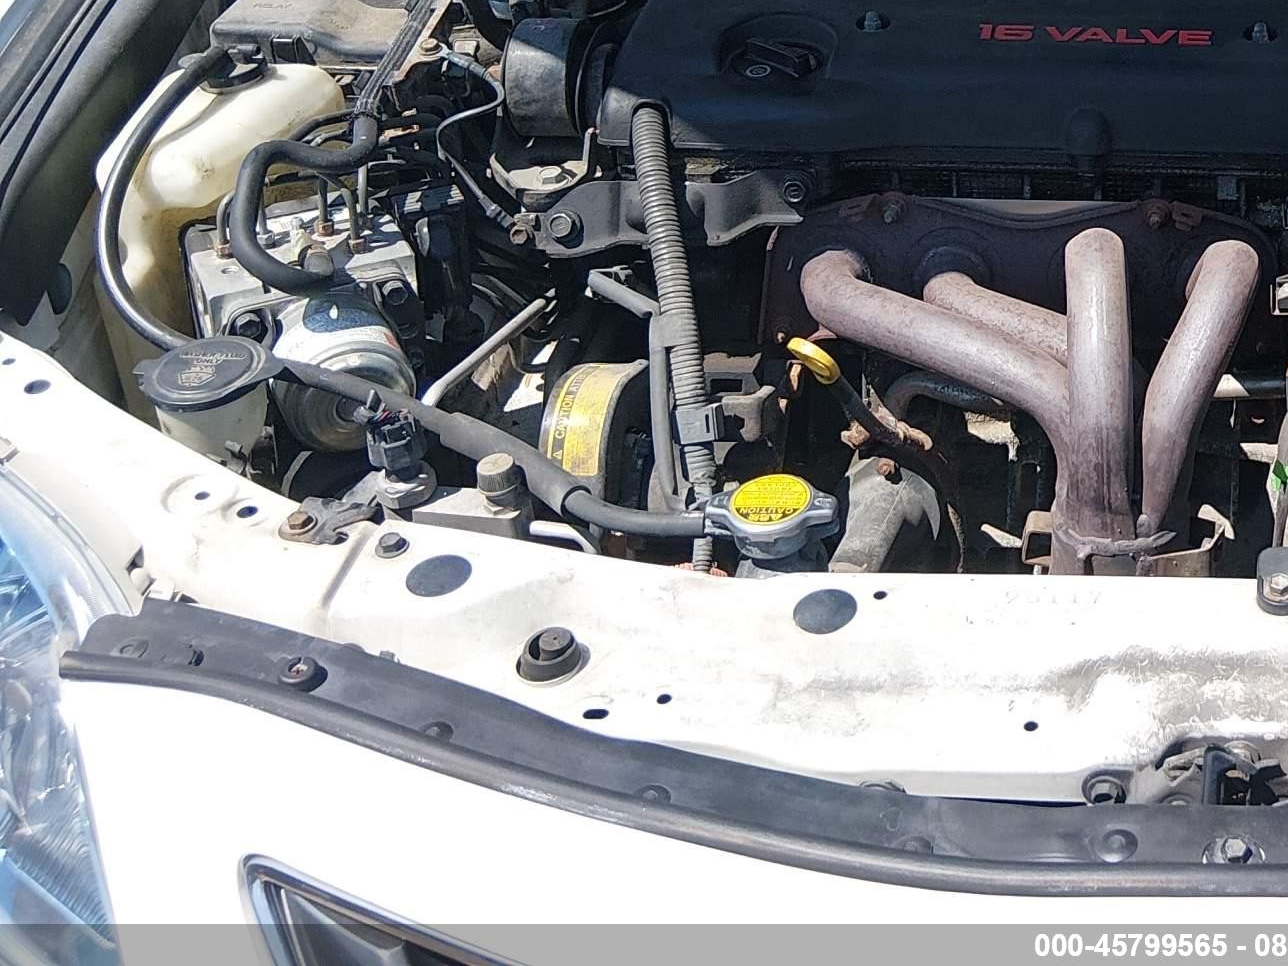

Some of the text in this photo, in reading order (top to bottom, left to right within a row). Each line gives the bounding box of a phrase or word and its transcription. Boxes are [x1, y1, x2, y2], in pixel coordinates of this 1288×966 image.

[978, 22, 1214, 47] 16 VALVE
[739, 507, 794, 515] CAUTION
